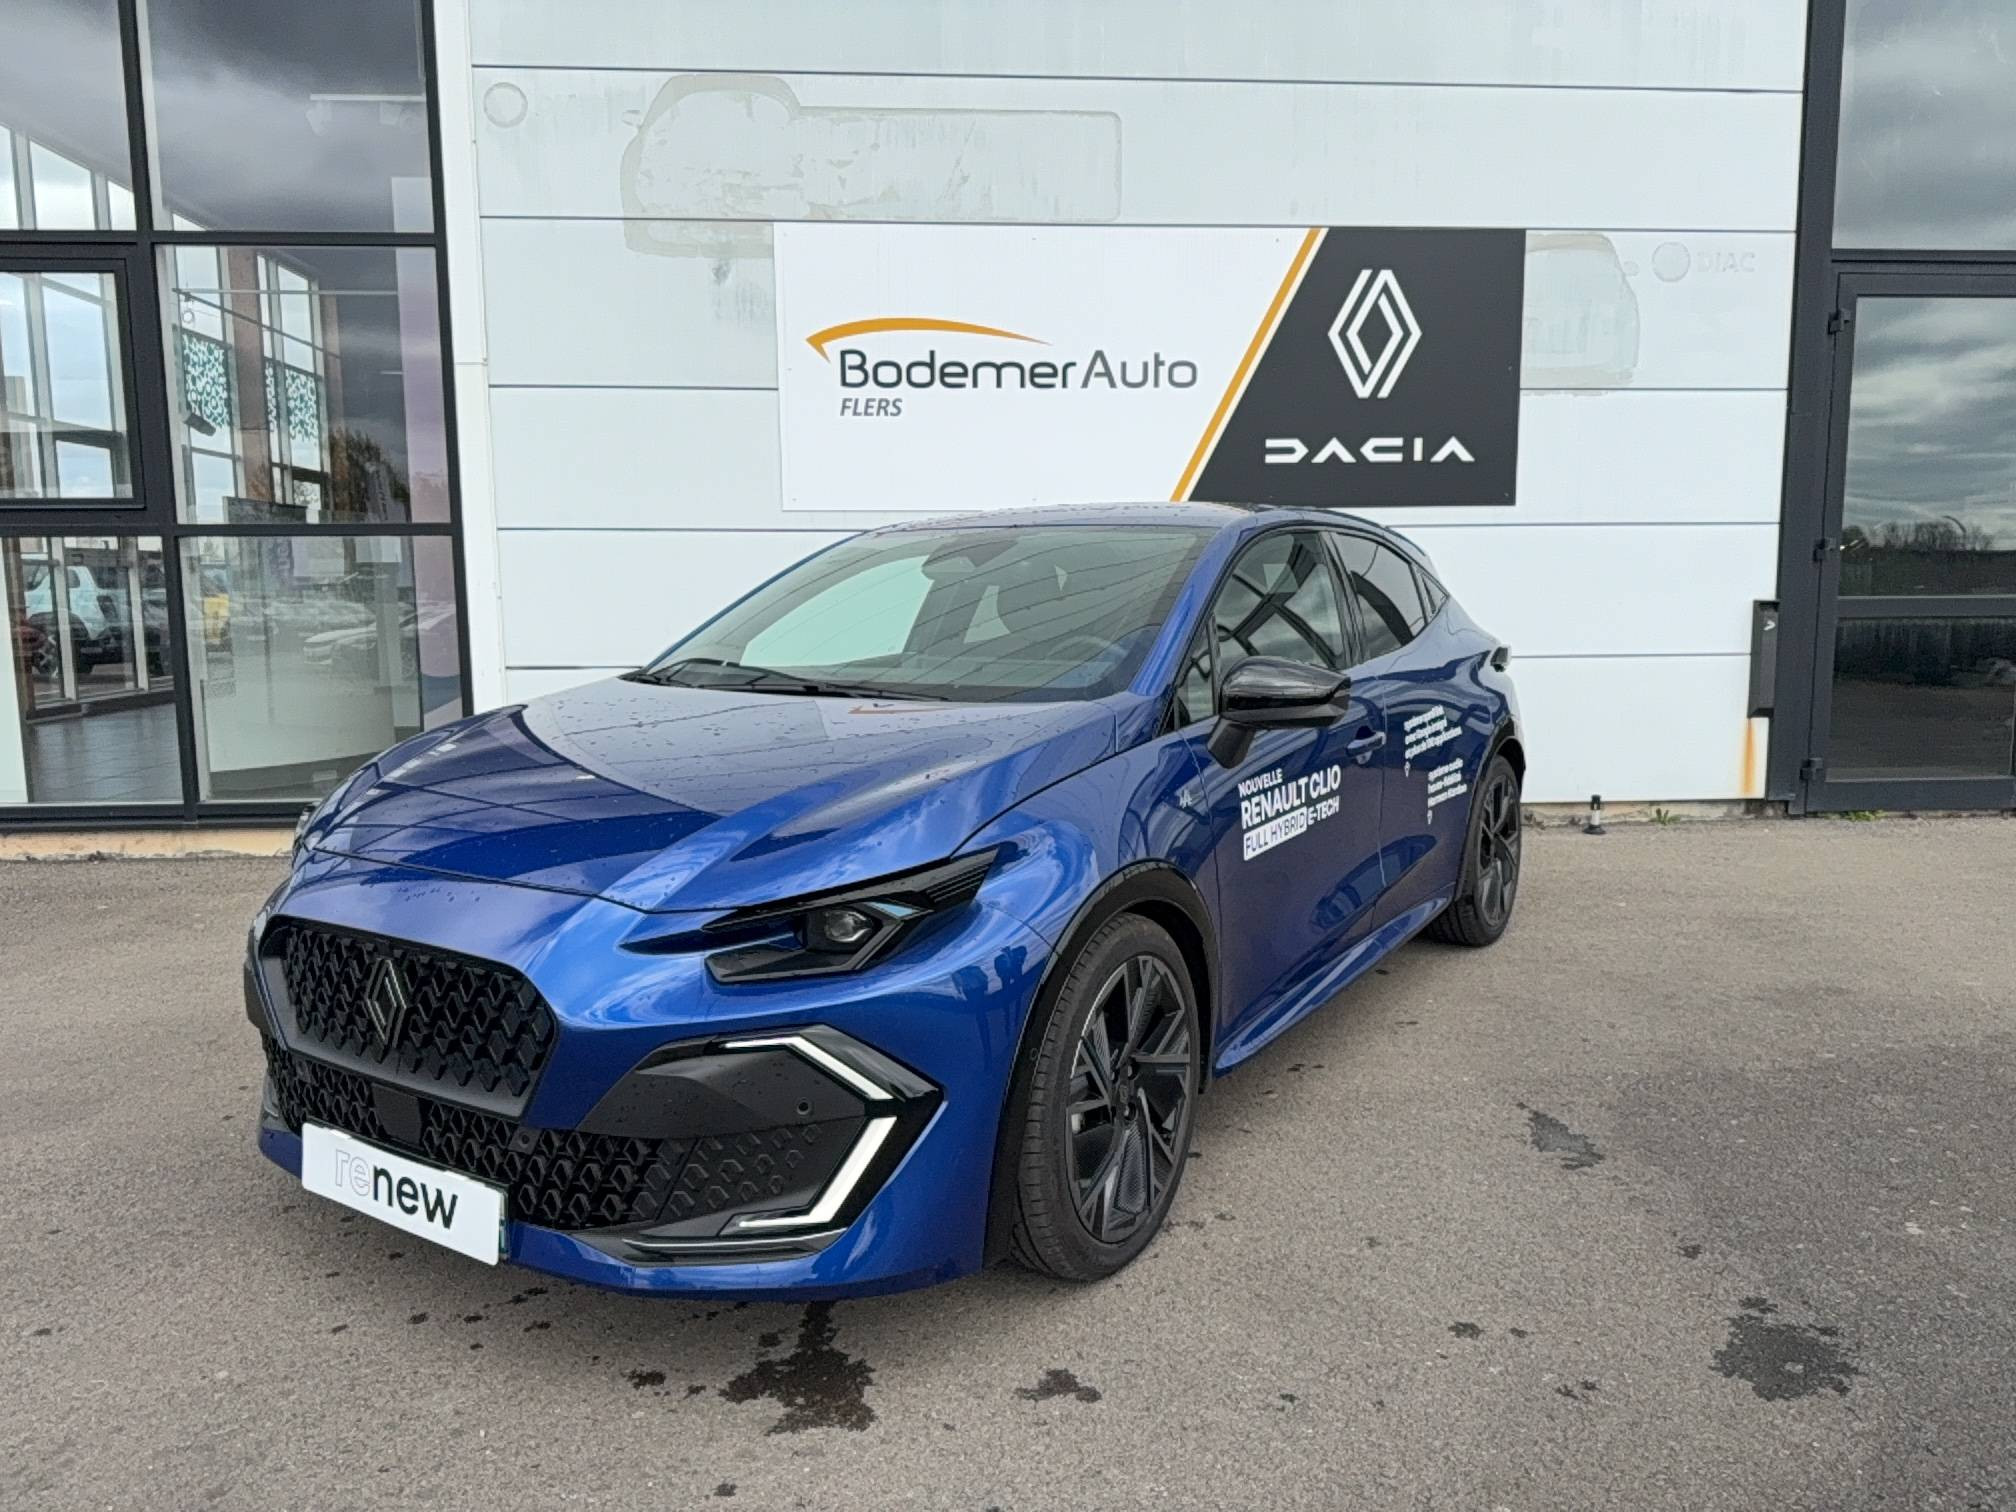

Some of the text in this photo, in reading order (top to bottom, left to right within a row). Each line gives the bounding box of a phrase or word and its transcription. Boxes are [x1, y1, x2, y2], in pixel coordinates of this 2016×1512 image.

[840, 397, 903, 417] FLERS
[1265, 436, 1475, 464] DACIA
[1238, 767, 1283, 798] NOUVELLE
[1241, 764, 1341, 829] RENAULT CLIO
[1245, 795, 1340, 857] FULL HYBRID E-TECH
[335, 1148, 458, 1230] renew
